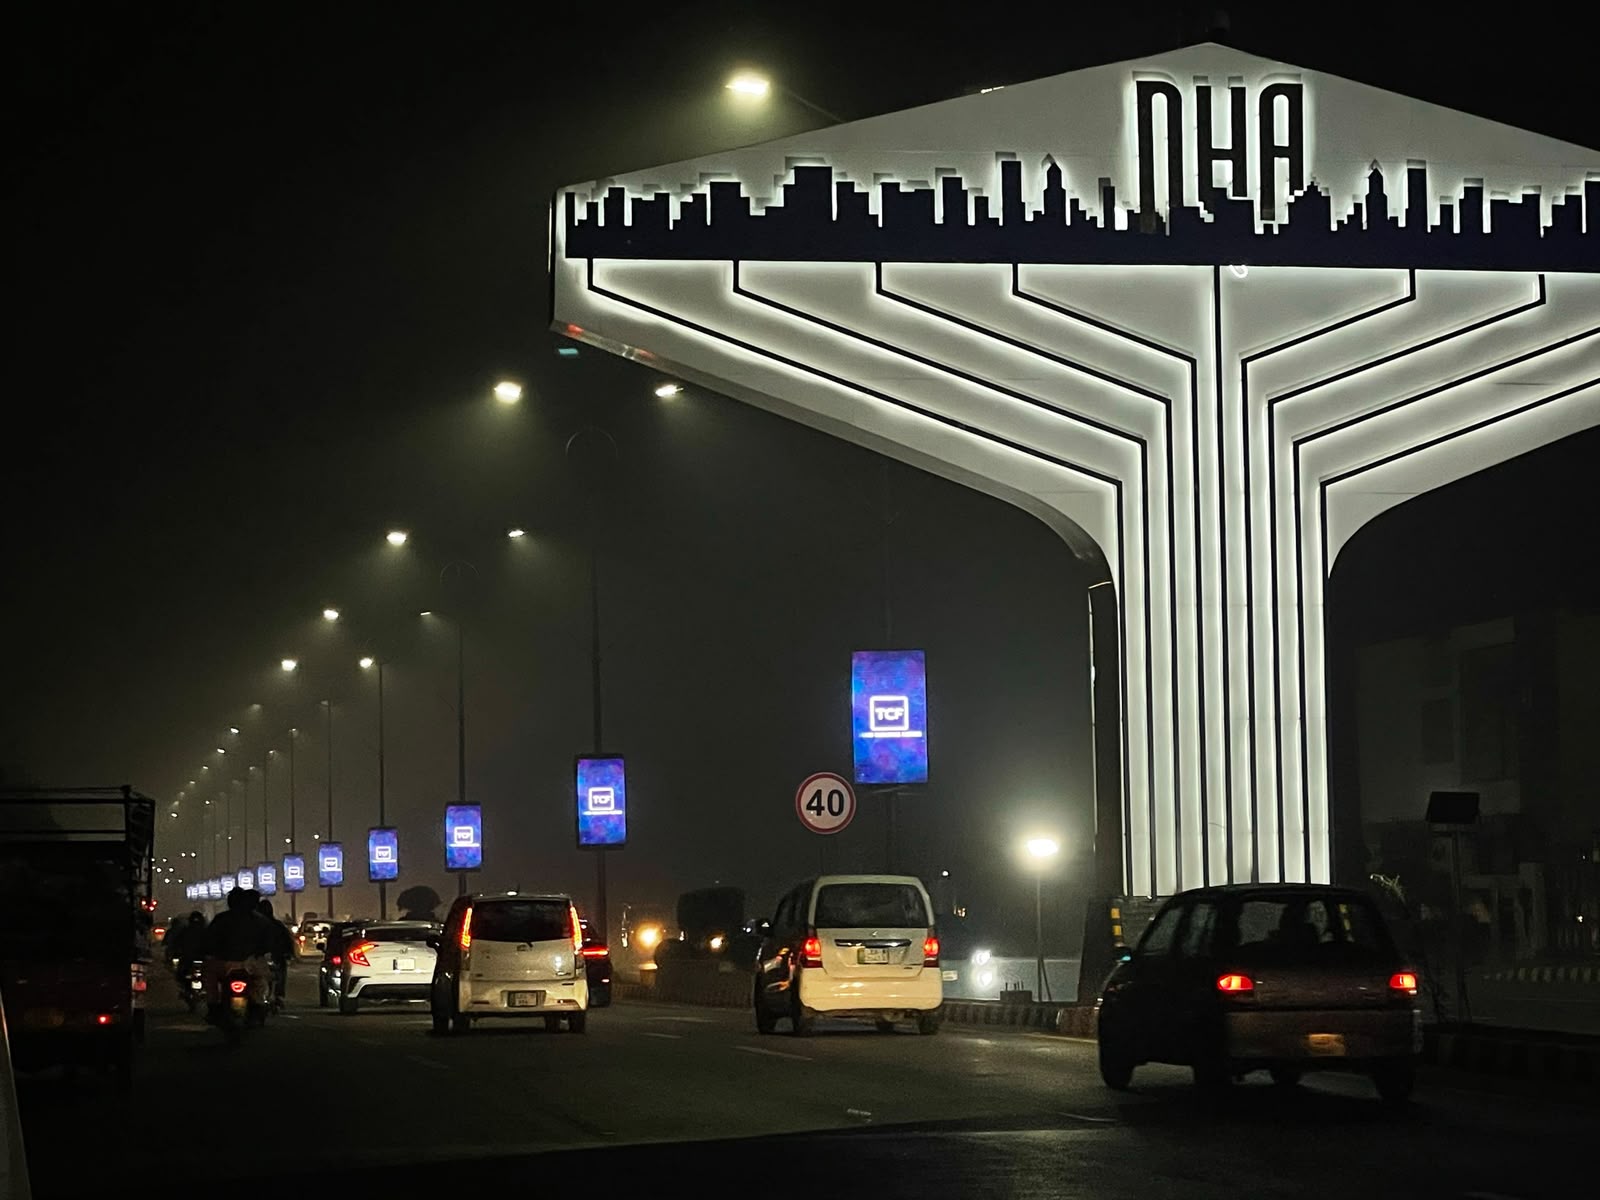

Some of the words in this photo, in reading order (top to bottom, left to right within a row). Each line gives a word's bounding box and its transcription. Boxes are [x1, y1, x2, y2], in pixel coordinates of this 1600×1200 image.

[1135, 80, 1304, 231] DHA
[875, 707, 904, 720] TCF
[806, 789, 844, 816] 40
